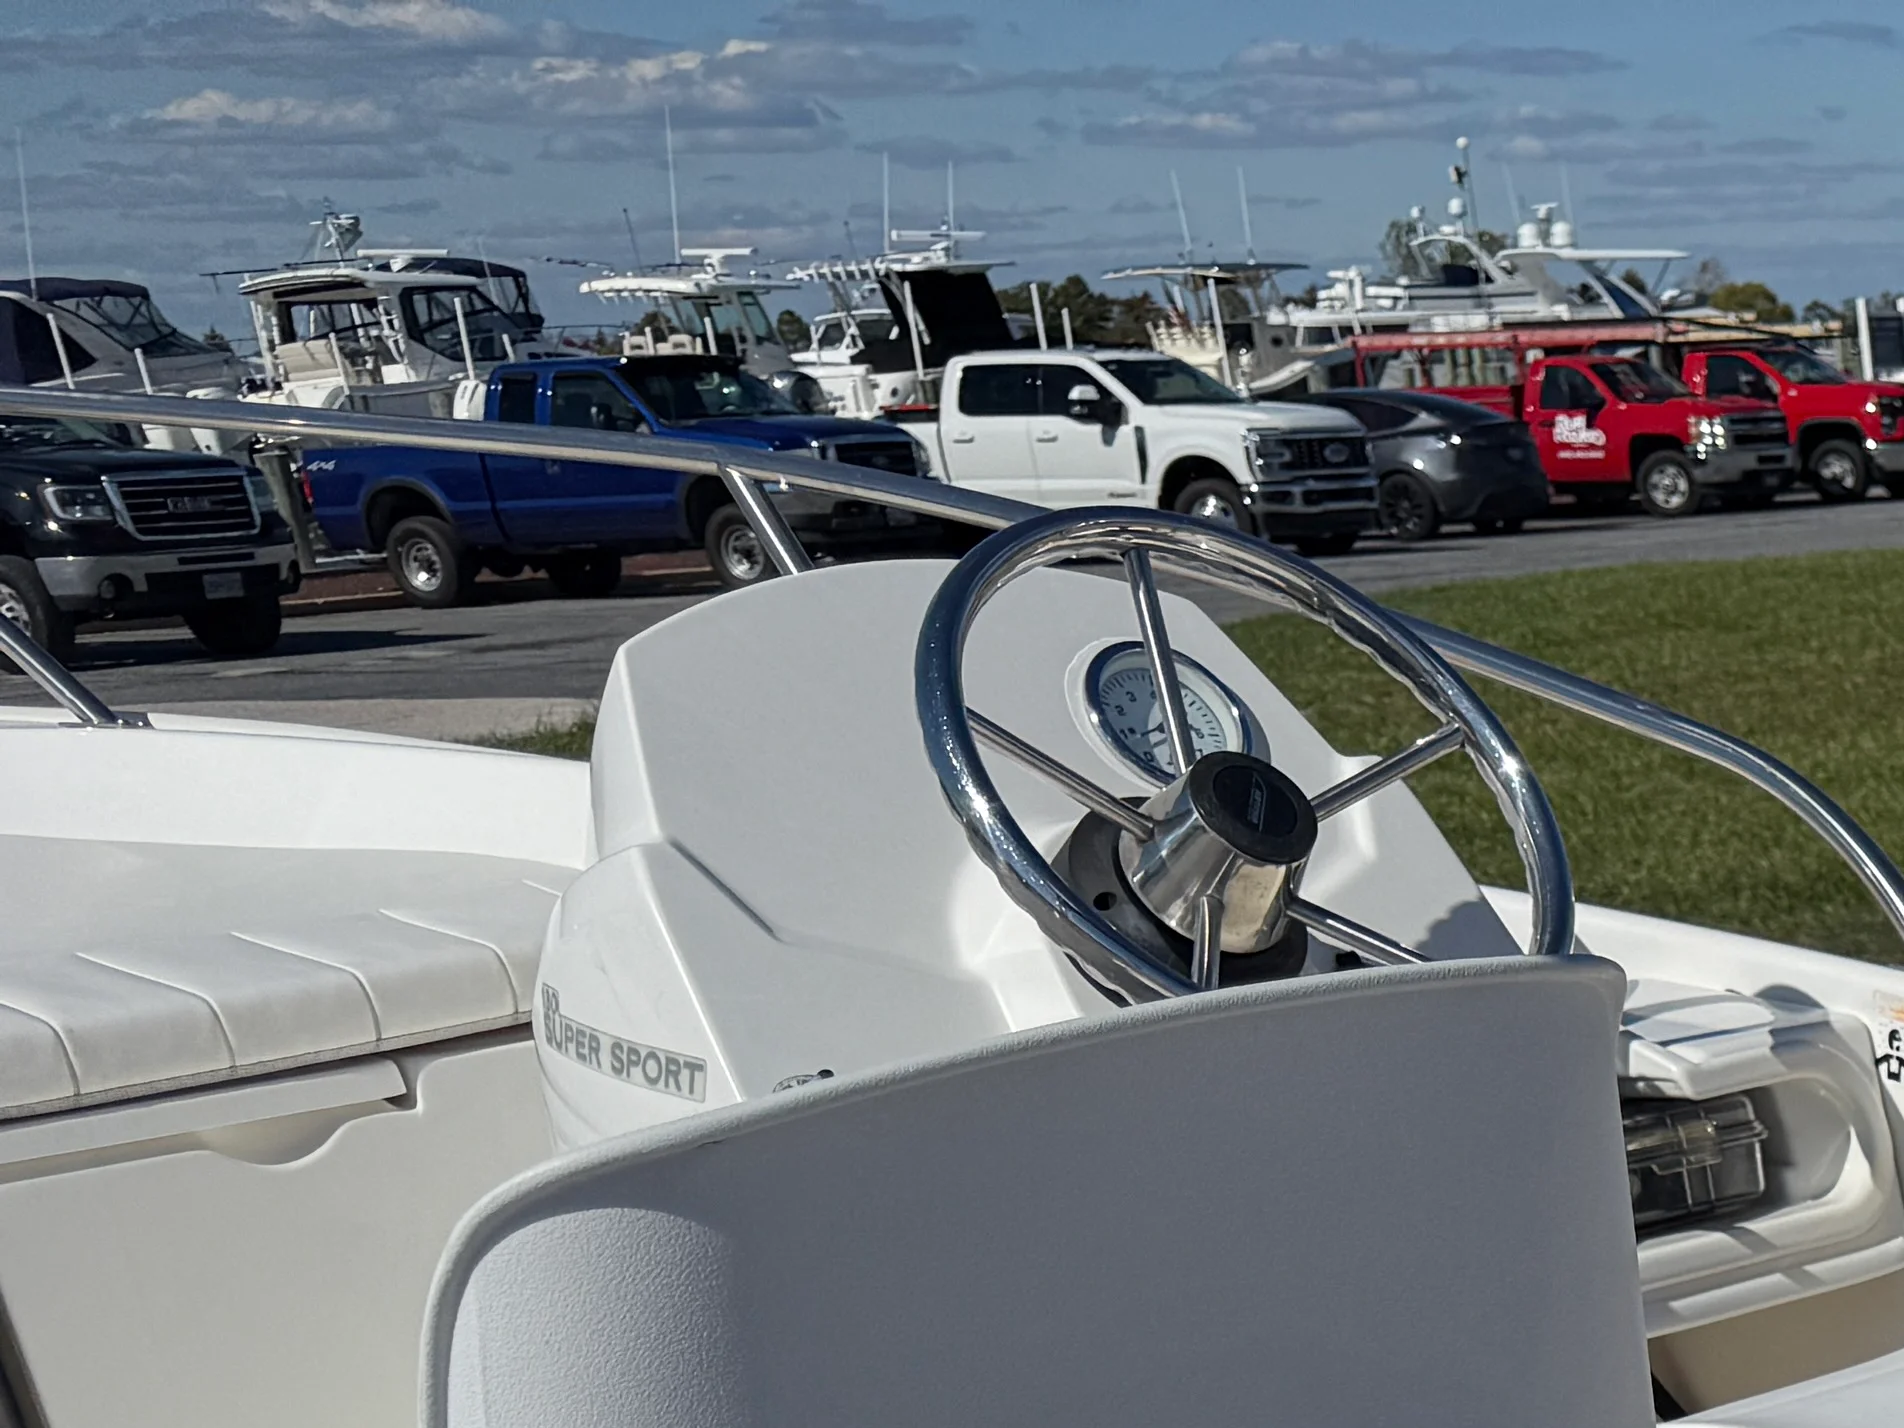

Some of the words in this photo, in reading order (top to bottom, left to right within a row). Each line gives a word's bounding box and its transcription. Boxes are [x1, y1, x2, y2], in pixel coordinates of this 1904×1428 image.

[1125, 690, 1137, 703] 3
[1114, 704, 1126, 717] 2
[544, 1011, 601, 1069] SUPER
[610, 1040, 704, 1096] SPORT
